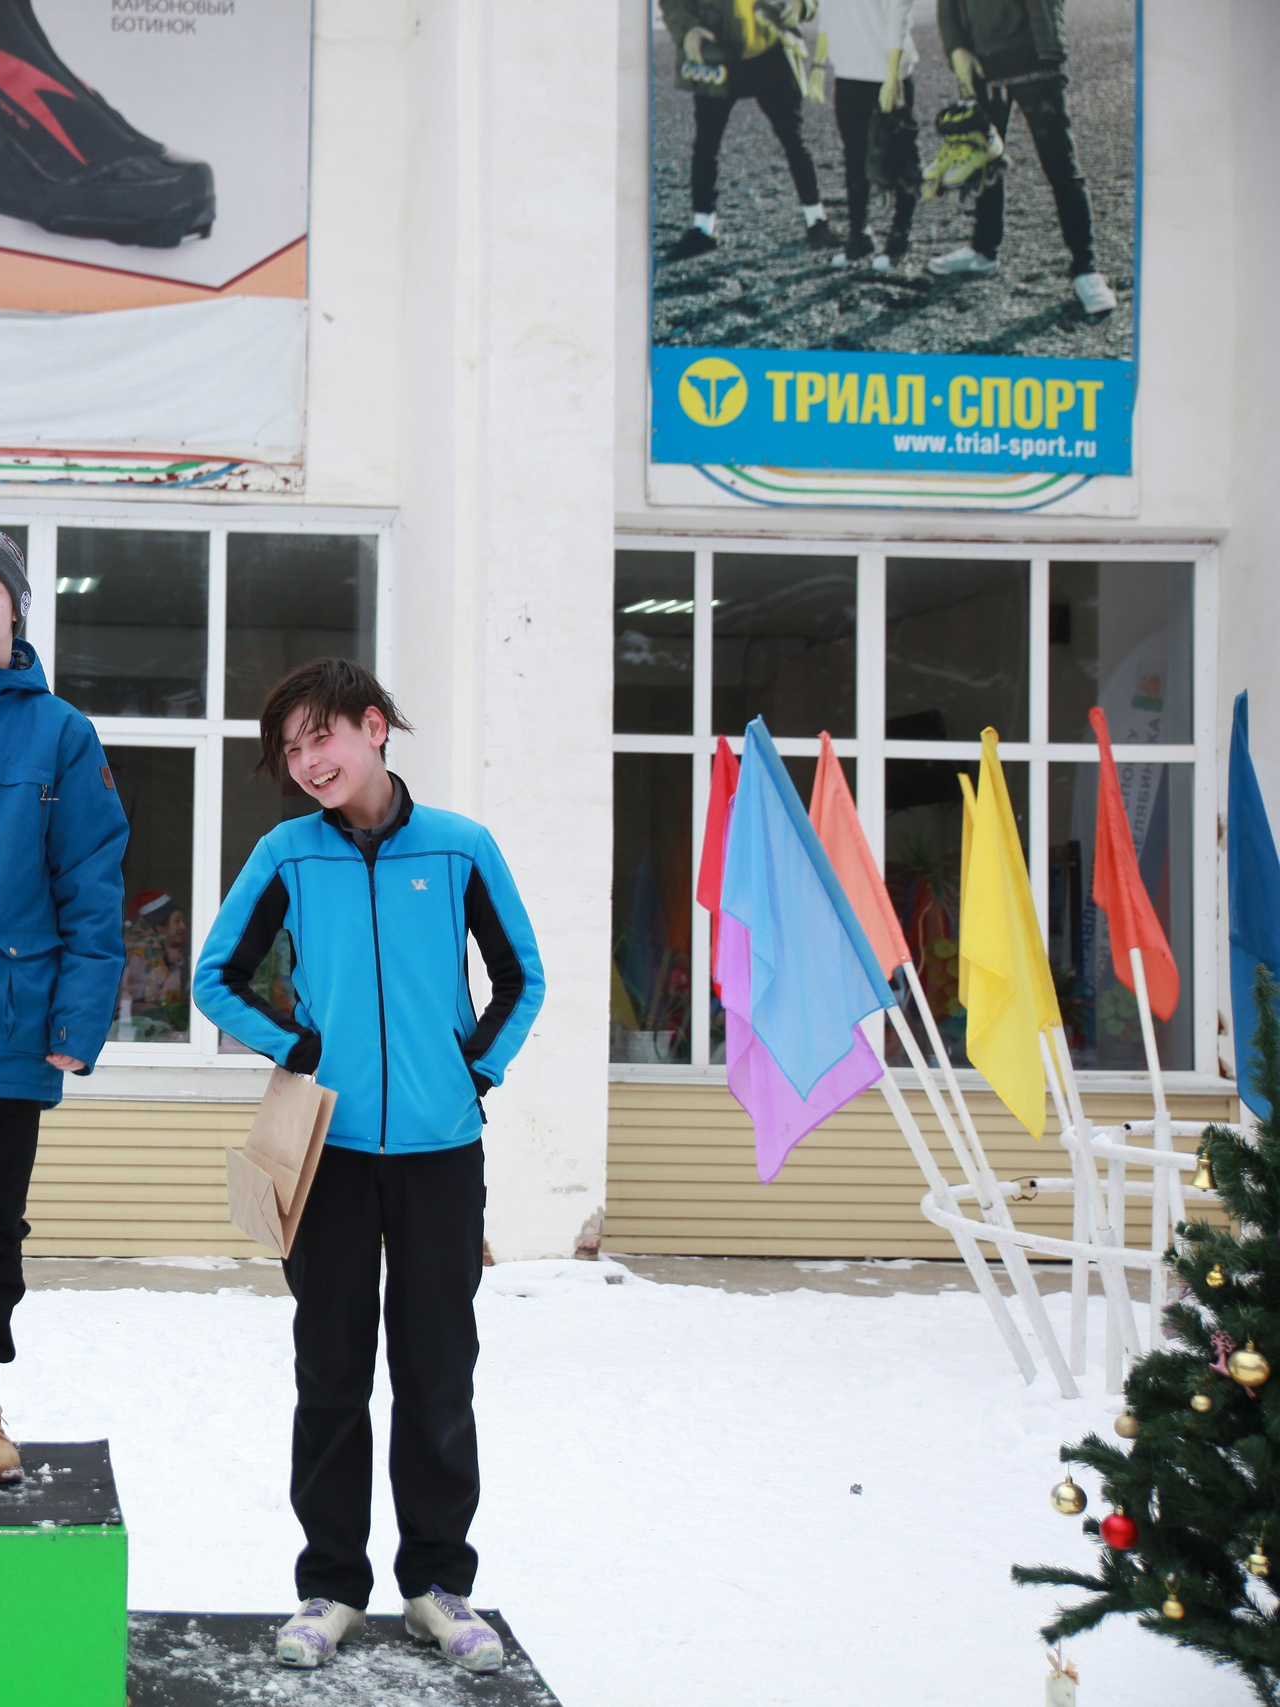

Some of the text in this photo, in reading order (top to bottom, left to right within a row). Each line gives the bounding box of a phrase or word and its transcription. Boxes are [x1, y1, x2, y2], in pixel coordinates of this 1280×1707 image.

[111, 0, 235, 16] КАРБОНОВЫЙ
[111, 16, 197, 35] БОТИНОК
[893, 432, 1098, 460] www.trial-sport.ru
[1134, 718, 1161, 853] ЕЛЯБИНКА
